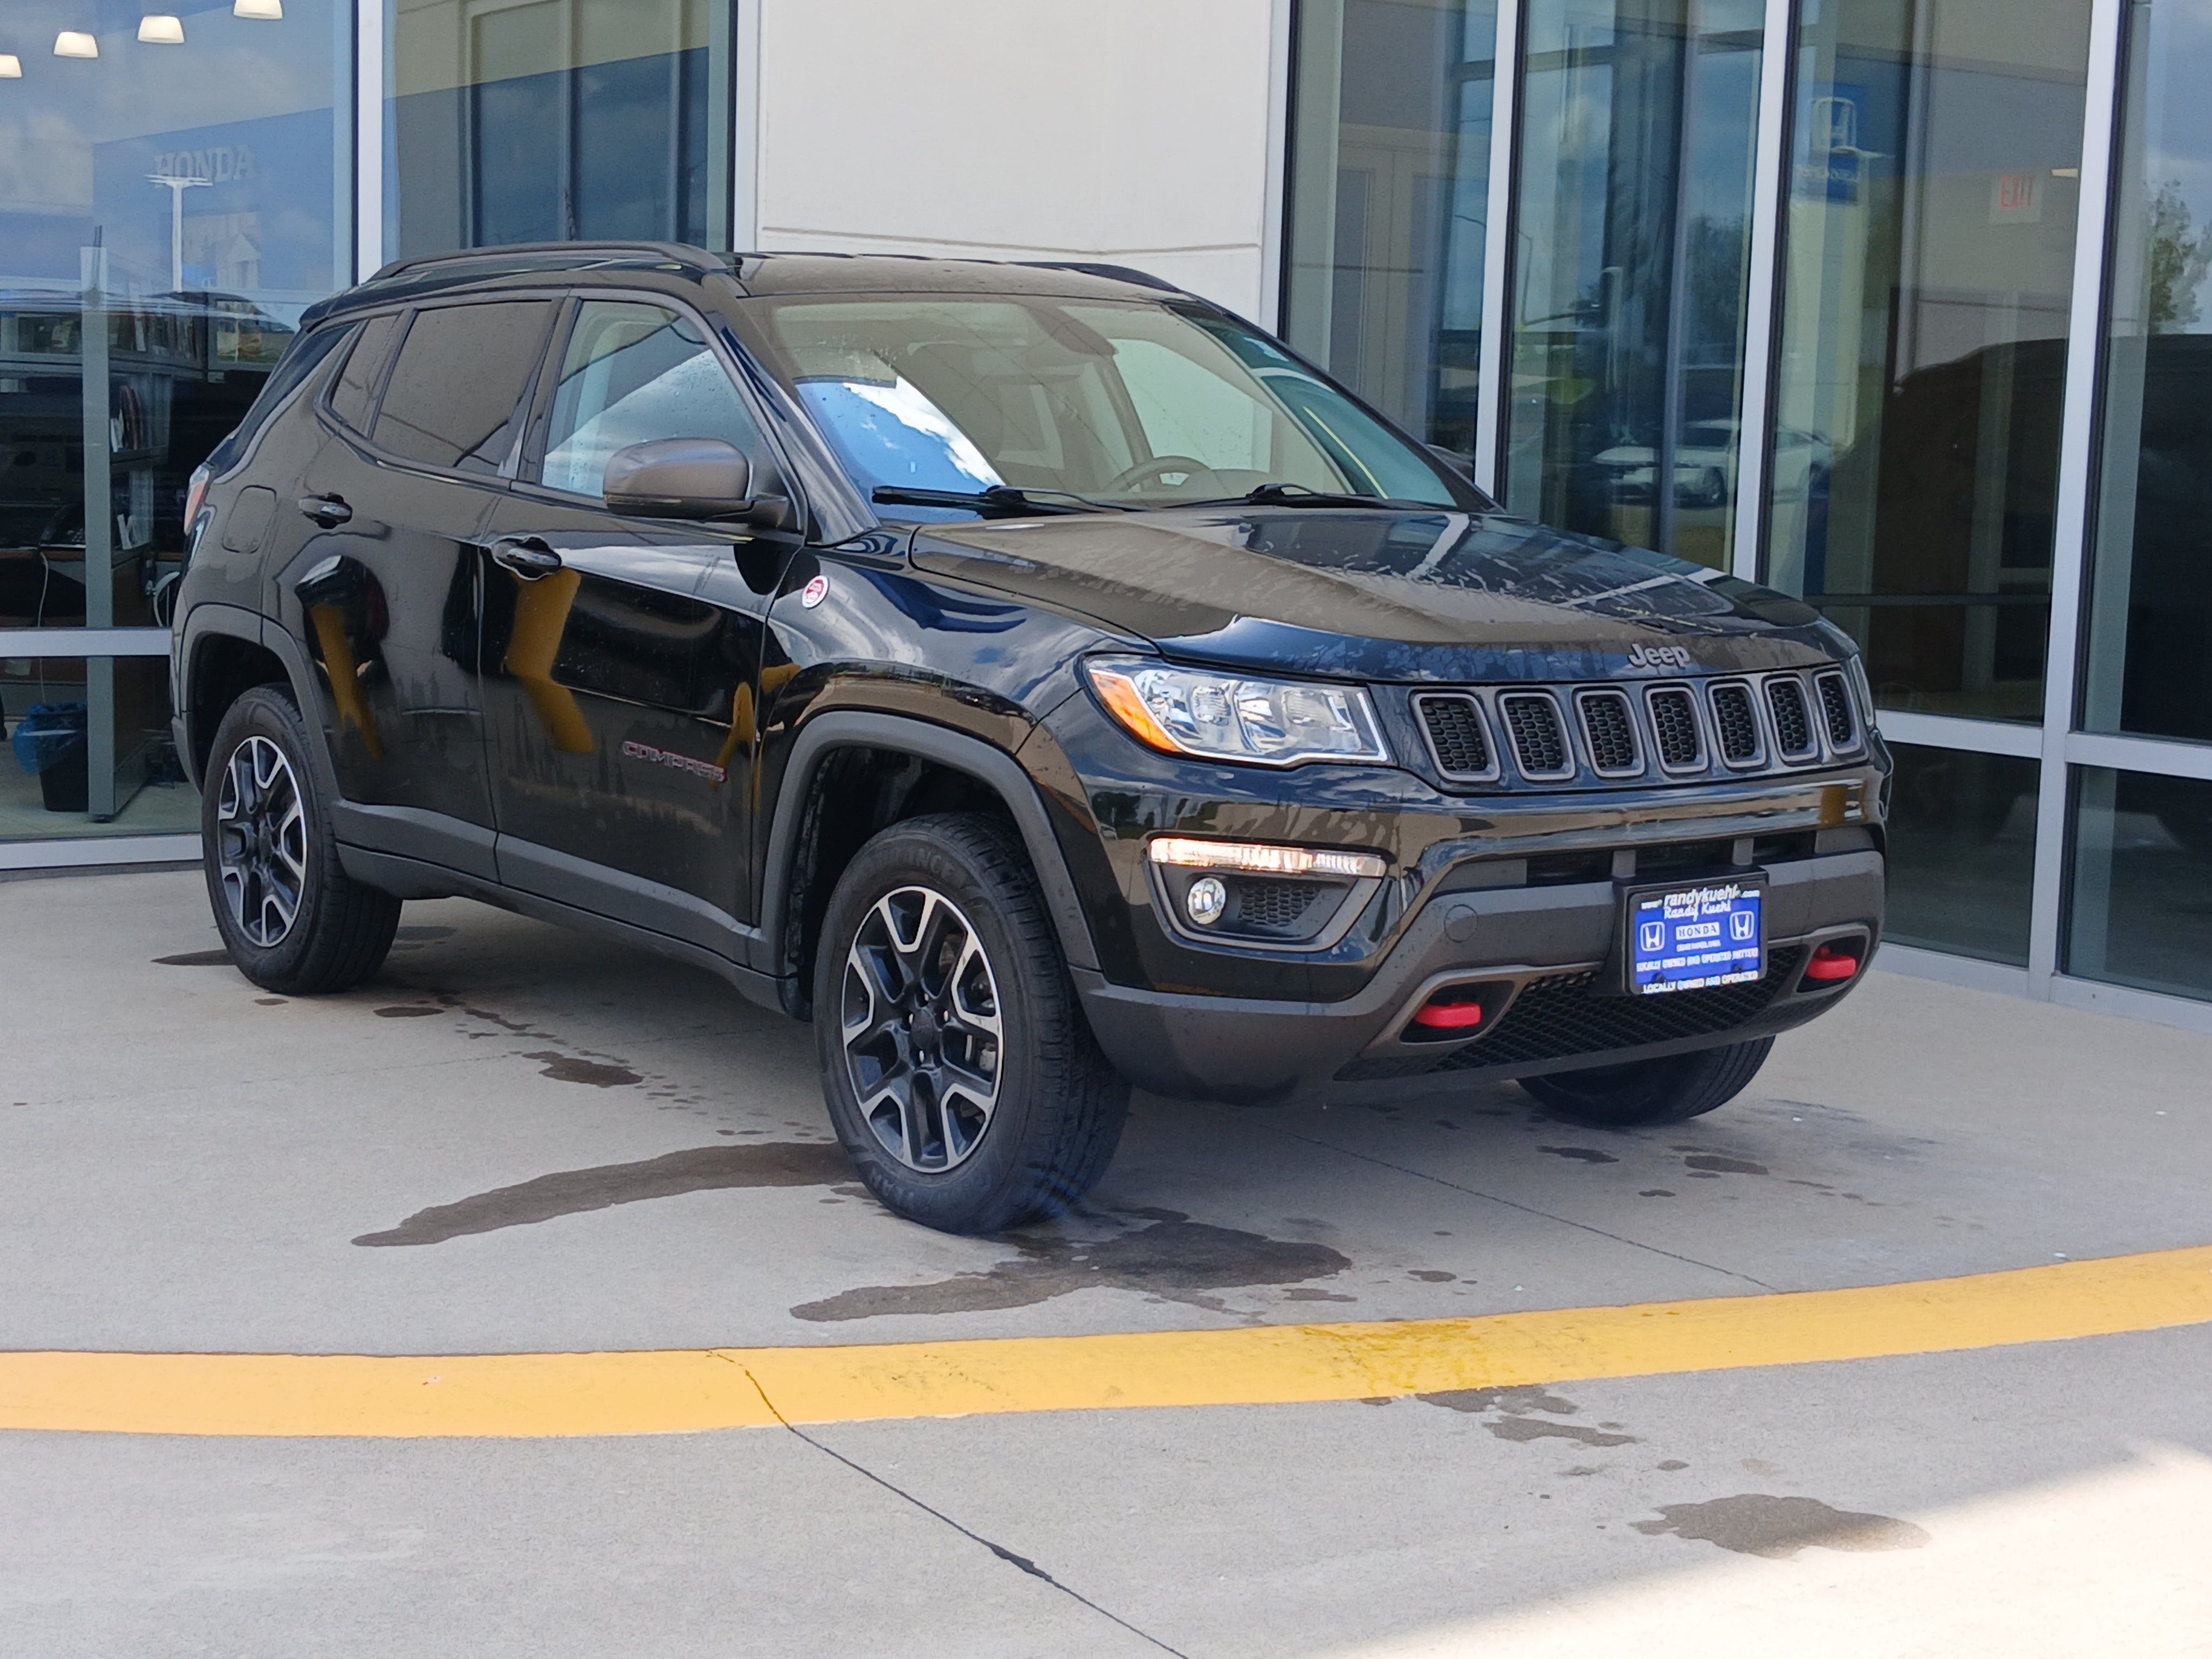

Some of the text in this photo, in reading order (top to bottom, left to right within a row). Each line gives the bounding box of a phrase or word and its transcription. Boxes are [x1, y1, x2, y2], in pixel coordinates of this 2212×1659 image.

[1999, 176, 2036, 209] EXIT
[1628, 643, 1690, 670] Jeep
[1664, 905, 1699, 922] Randy
[1678, 927, 1718, 937] HONDA
